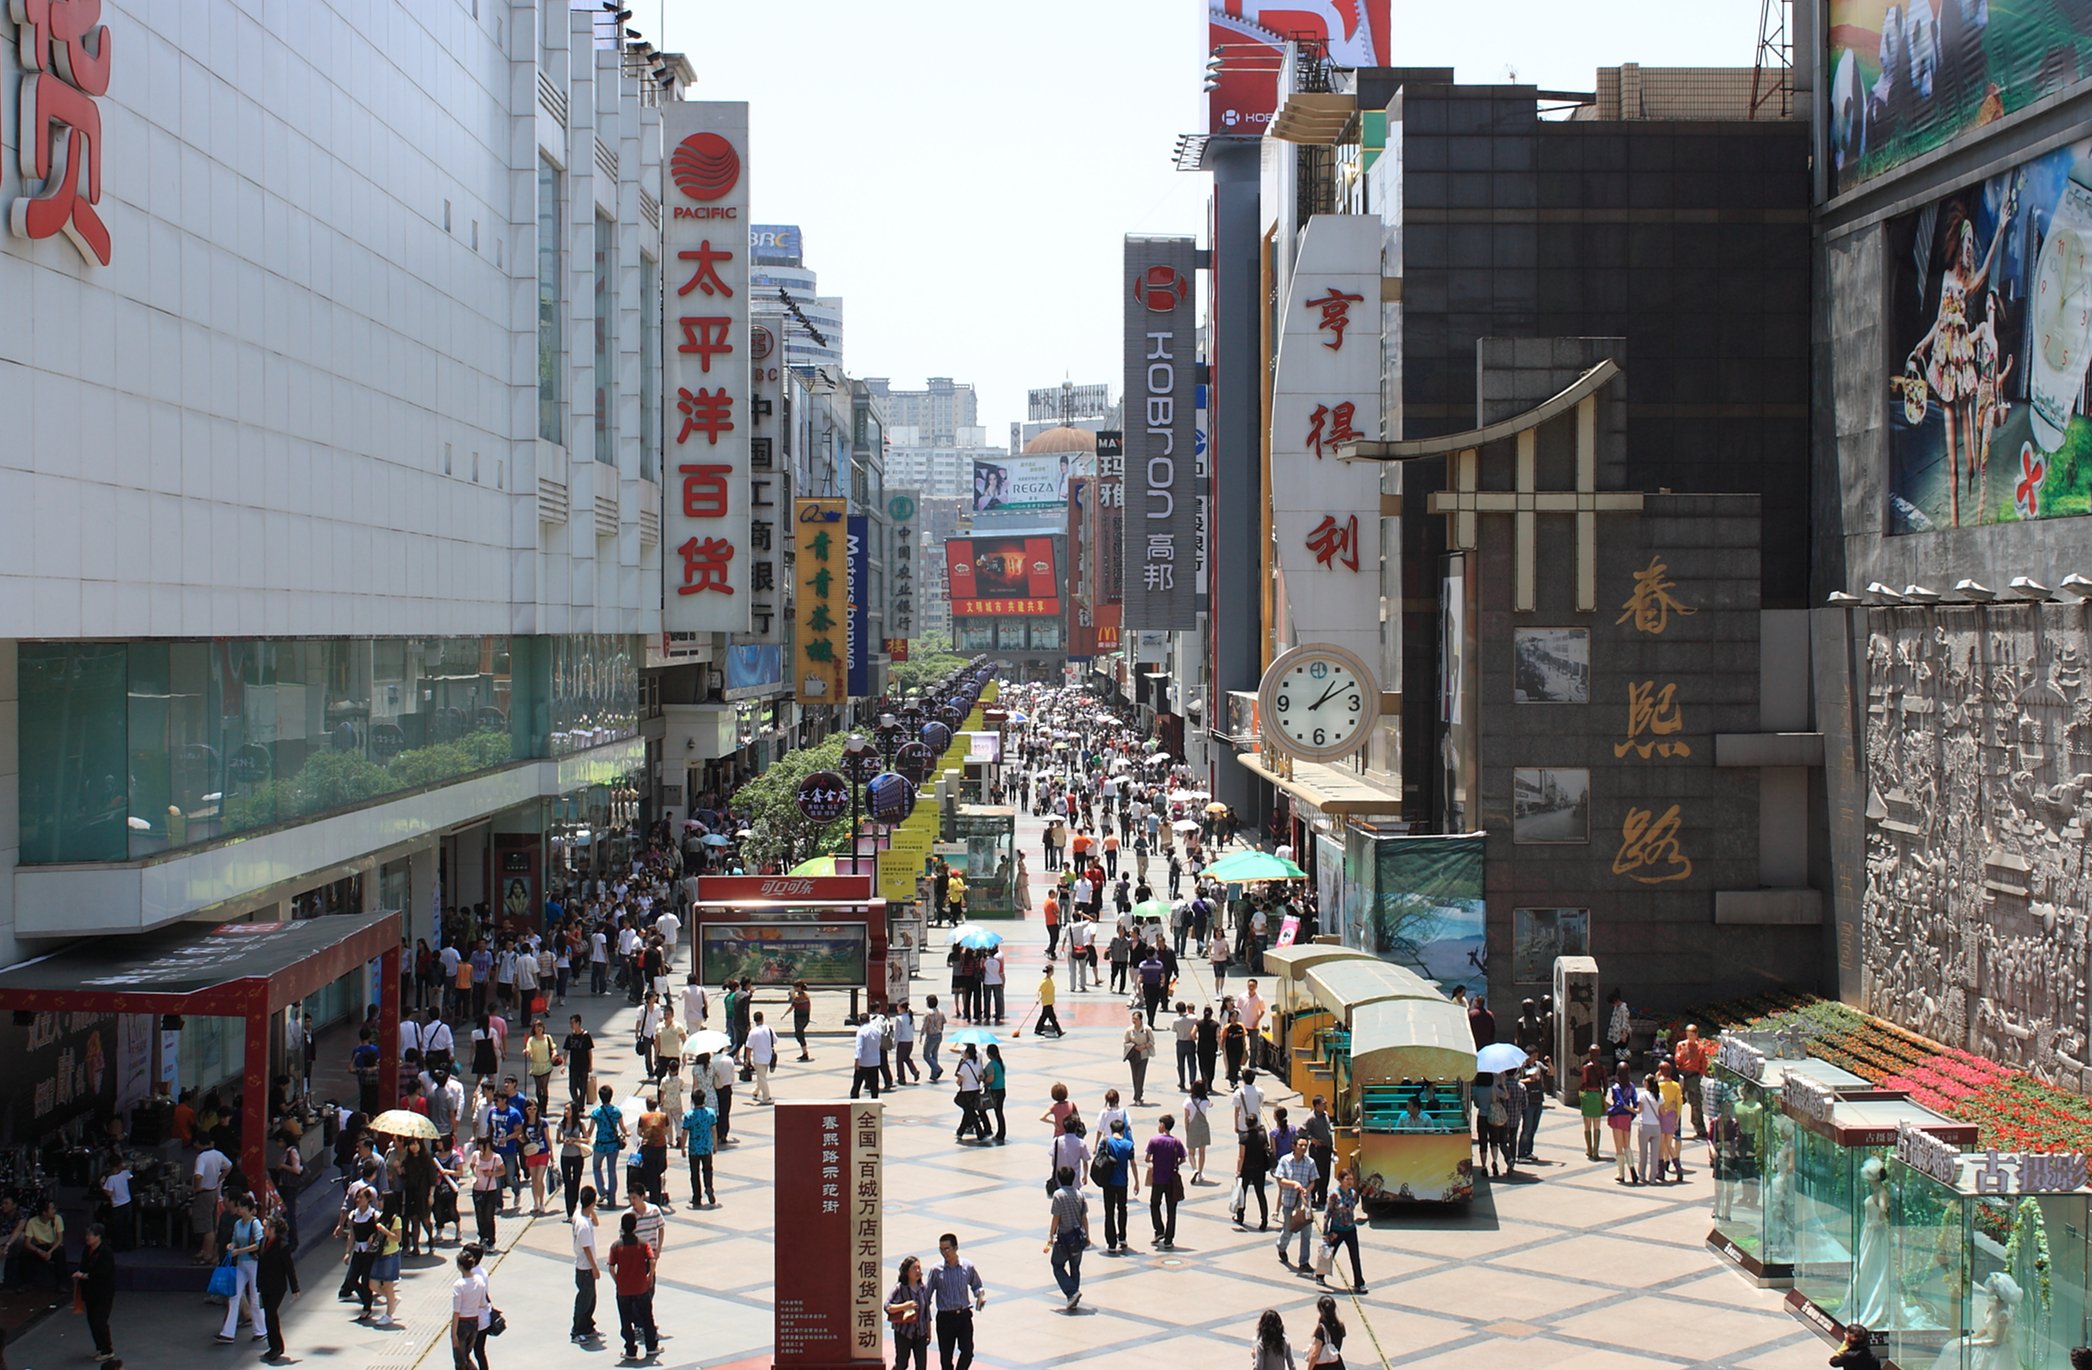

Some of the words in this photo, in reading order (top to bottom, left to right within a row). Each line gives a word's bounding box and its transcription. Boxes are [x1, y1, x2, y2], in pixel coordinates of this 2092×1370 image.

[673, 207, 737, 220] PACIFIC
[677, 239, 734, 595] 太平洋百货
[1305, 287, 1365, 574] 亨得利
[1013, 482, 1054, 493] REGZA
[1143, 533, 1174, 591] 高邦
[895, 526, 914, 631] 中国农业银行
[966, 601, 1002, 613] 文明城市
[1277, 695, 1290, 712] 9
[1348, 694, 1360, 711] 3
[1313, 728, 1325, 745] 6
[761, 879, 816, 897] 可口可乐
[822, 1115, 839, 1214] 春熙路示范街
